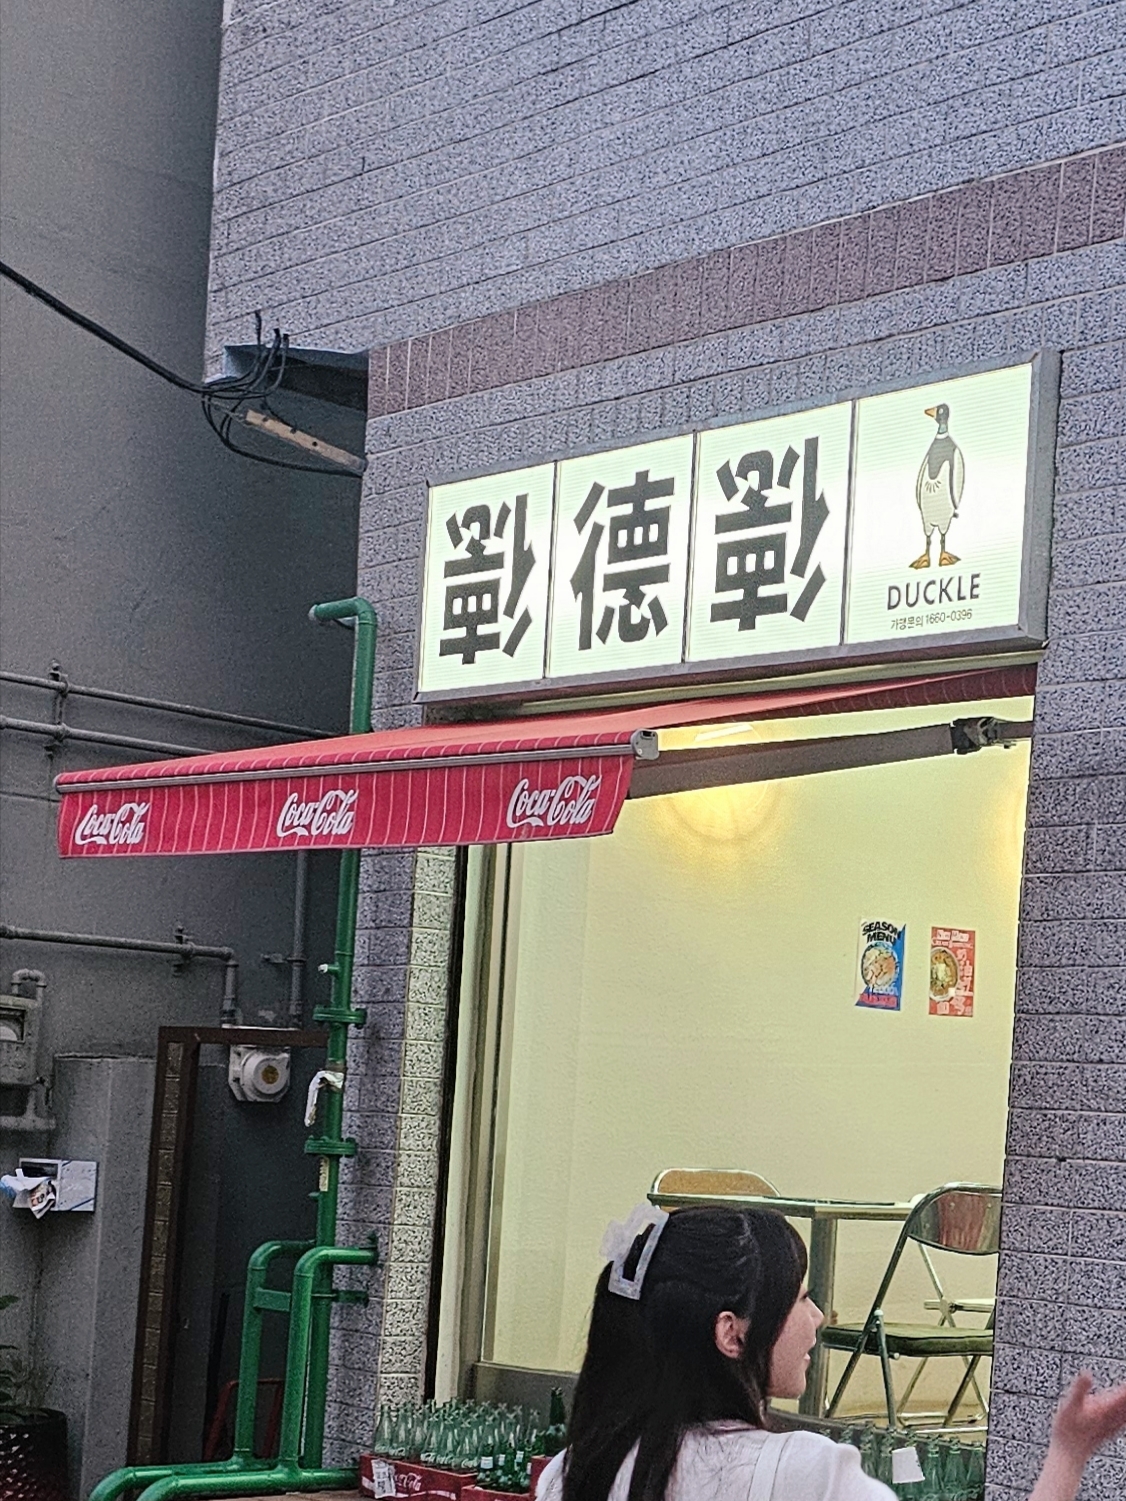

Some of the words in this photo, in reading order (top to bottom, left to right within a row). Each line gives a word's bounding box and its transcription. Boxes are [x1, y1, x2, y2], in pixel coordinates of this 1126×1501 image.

[887, 573, 981, 611] DUCKLE
[277, 789, 359, 837] Coca-Cola
[507, 774, 601, 829] Coca-Cola
[75, 802, 149, 846] Coca-Cola
[861, 921, 901, 939] SEASON
[866, 931, 897, 944] MENU
